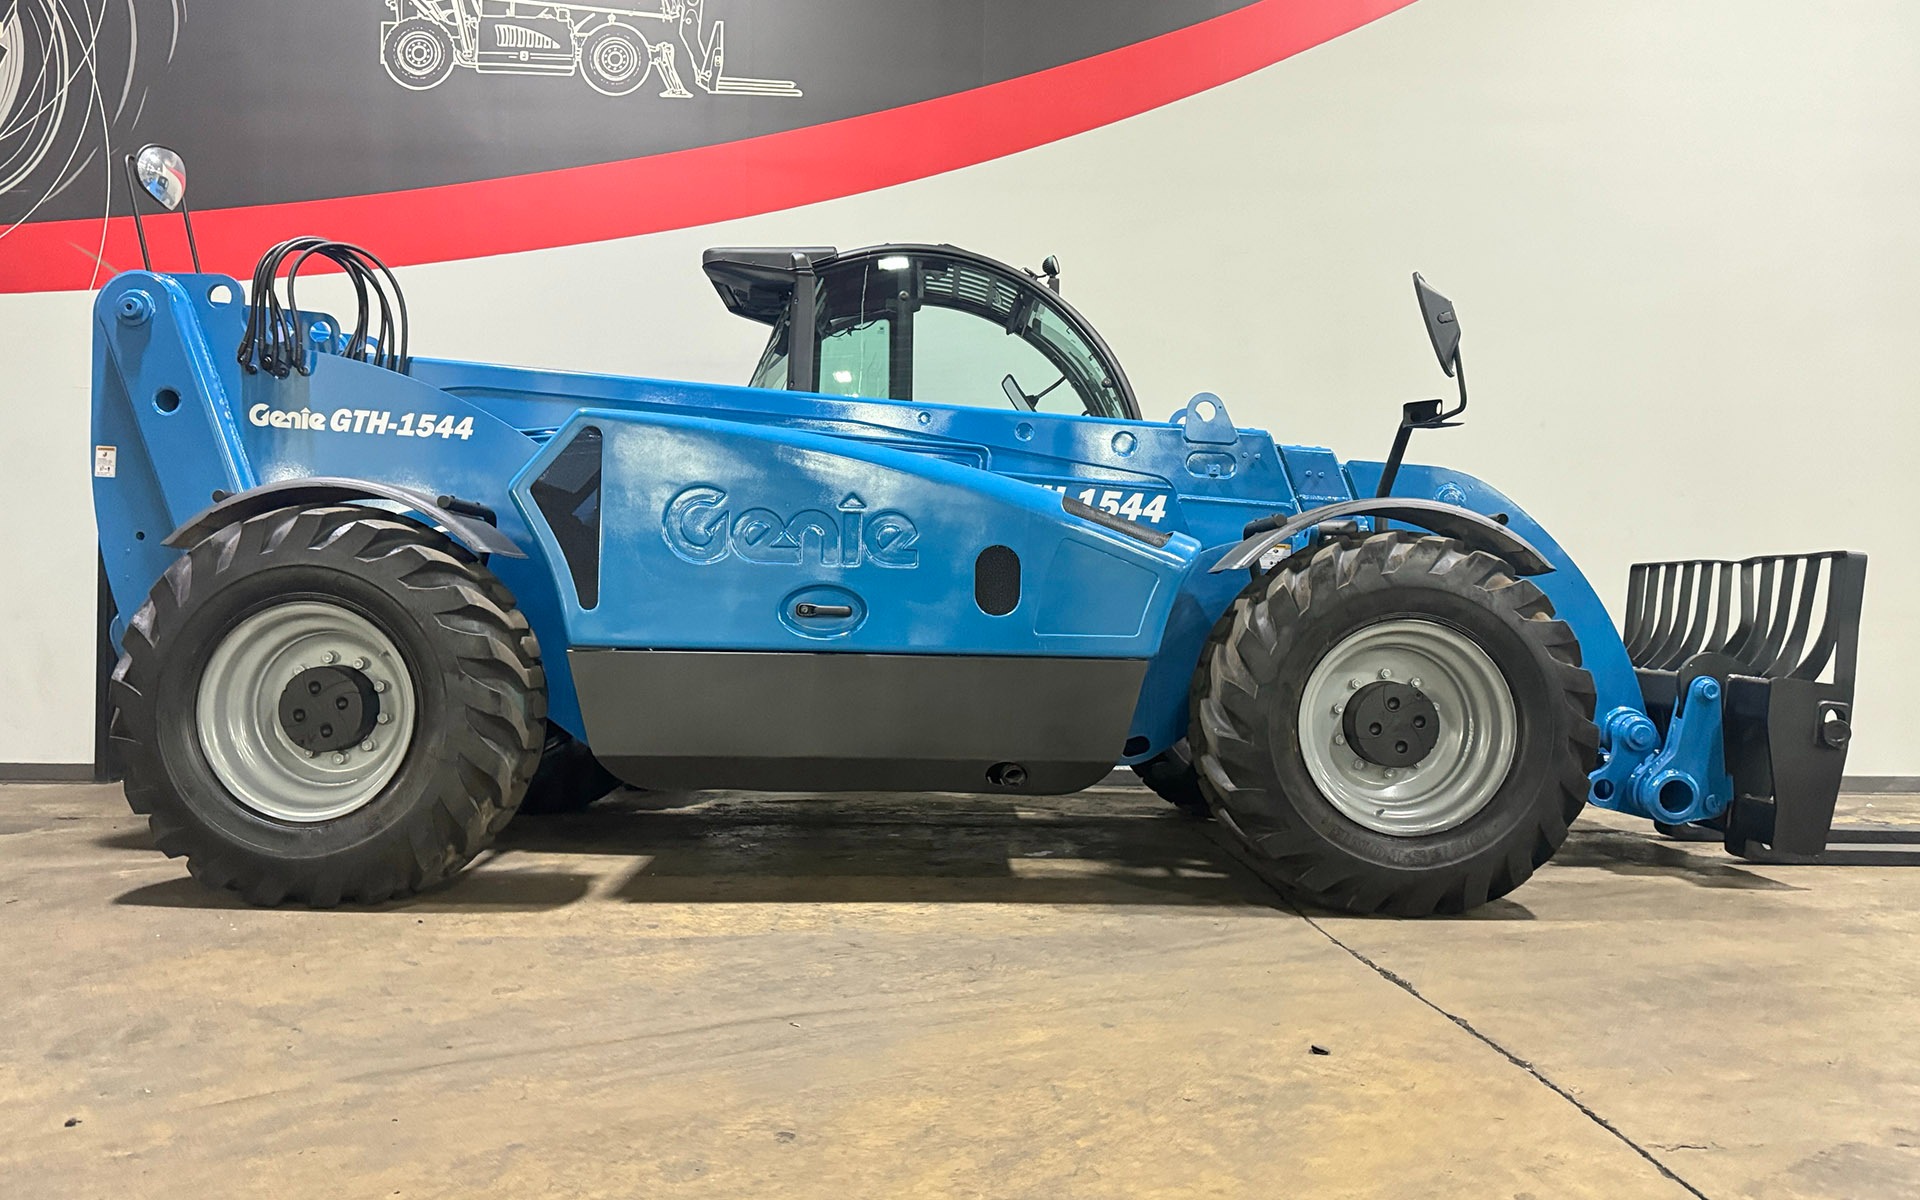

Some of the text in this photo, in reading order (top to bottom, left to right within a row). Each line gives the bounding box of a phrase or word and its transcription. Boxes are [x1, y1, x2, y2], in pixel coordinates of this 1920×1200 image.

[249, 403, 474, 440] Genie GTH-1544
[662, 484, 919, 568] Genie
